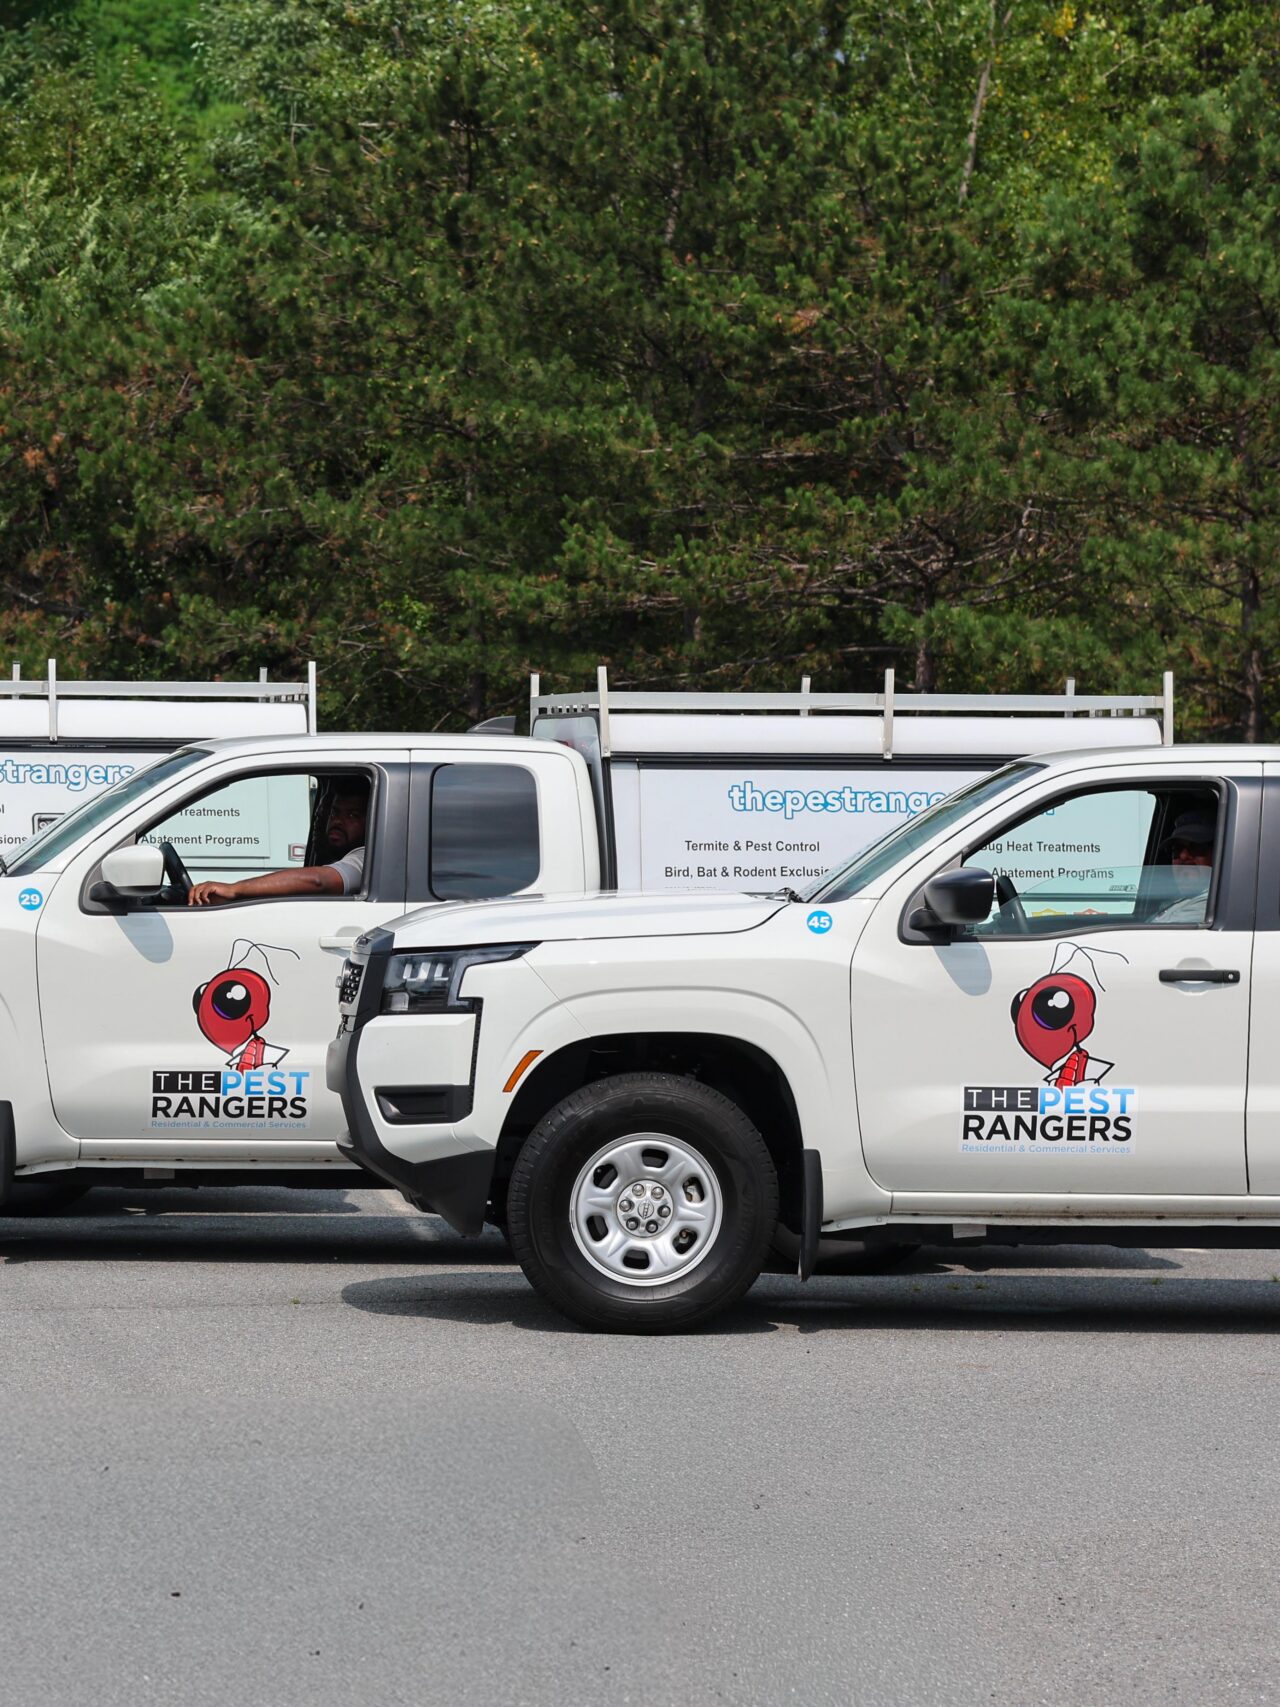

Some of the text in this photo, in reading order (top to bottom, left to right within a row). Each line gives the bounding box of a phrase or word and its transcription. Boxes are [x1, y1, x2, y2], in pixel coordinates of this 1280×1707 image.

[141, 834, 260, 848] Abatement Programs
[684, 840, 820, 853] Termite & Pest Control
[1006, 840, 1033, 852] Heat
[1036, 841, 1101, 853] Treatments
[665, 866, 830, 879] Bird, Bat & Rodent Exclusi
[991, 866, 1115, 881] Abatement Programs
[20, 894, 40, 906] 29
[808, 916, 830, 928] 45
[156, 1071, 309, 1096] THE PEST
[151, 1096, 308, 1119] RANGERS
[967, 1087, 1135, 1115] THE PEST
[151, 1120, 200, 1128] Residential
[212, 1121, 266, 1129] Commercial
[269, 1121, 306, 1129] Services
[962, 1114, 1132, 1142] RANGERS
[962, 1144, 1131, 1154] Residential & Commercial Services
